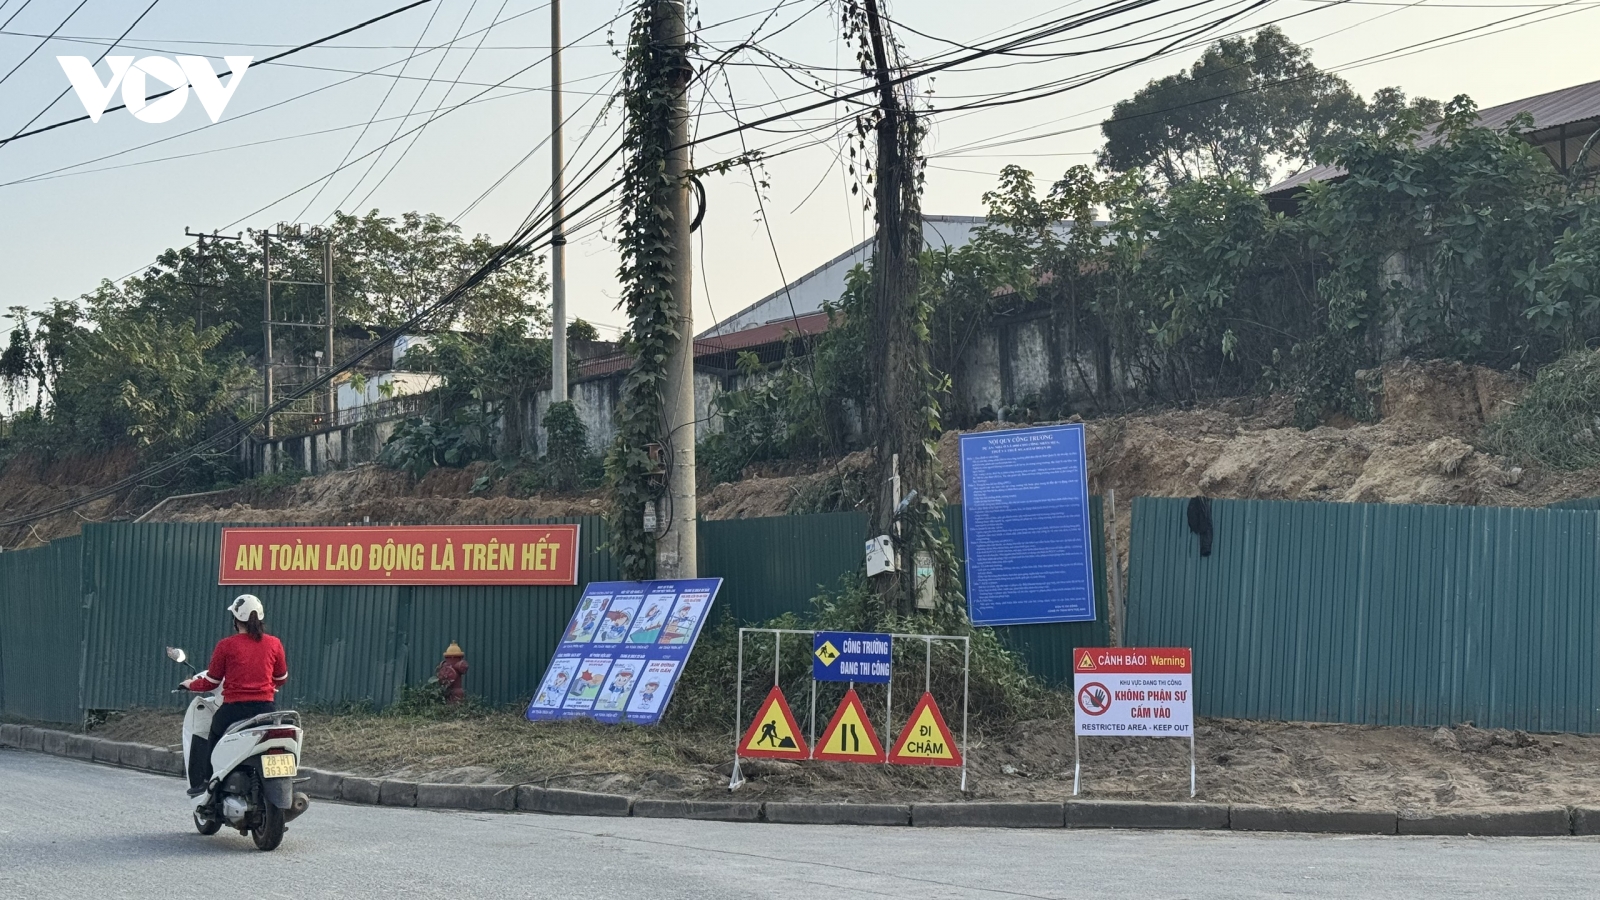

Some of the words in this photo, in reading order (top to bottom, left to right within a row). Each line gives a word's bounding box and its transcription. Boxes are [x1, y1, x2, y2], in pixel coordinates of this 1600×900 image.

[235, 544, 263, 571] AN
[269, 538, 320, 571] TOÀN
[325, 544, 363, 571] LAO
[369, 538, 425, 576] ĐỘNG
[430, 538, 455, 571] LÀ
[462, 537, 515, 570] TRÊN
[521, 533, 560, 570] HẾT
[843, 638, 861, 653] CÔNG
[862, 638, 889, 655] TRƯỜNG
[1098, 652, 1123, 666] CẢNH
[1125, 652, 1147, 666] BÁO!
[1151, 655, 1185, 668] Warning
[840, 661, 858, 675] ĐANG
[860, 662, 870, 675] THI
[871, 660, 889, 676] CÔNG
[1115, 689, 1145, 701] KHÔNG
[1148, 689, 1172, 704] PHẬN
[1174, 690, 1187, 703] SỰ
[1131, 704, 1151, 719] CẤM
[920, 726, 931, 737] ĐI
[1174, 724, 1189, 732] OUT
[907, 740, 942, 756] CHẬM
[267, 756, 289, 766] 28-H1
[265, 766, 293, 776] 363.30
